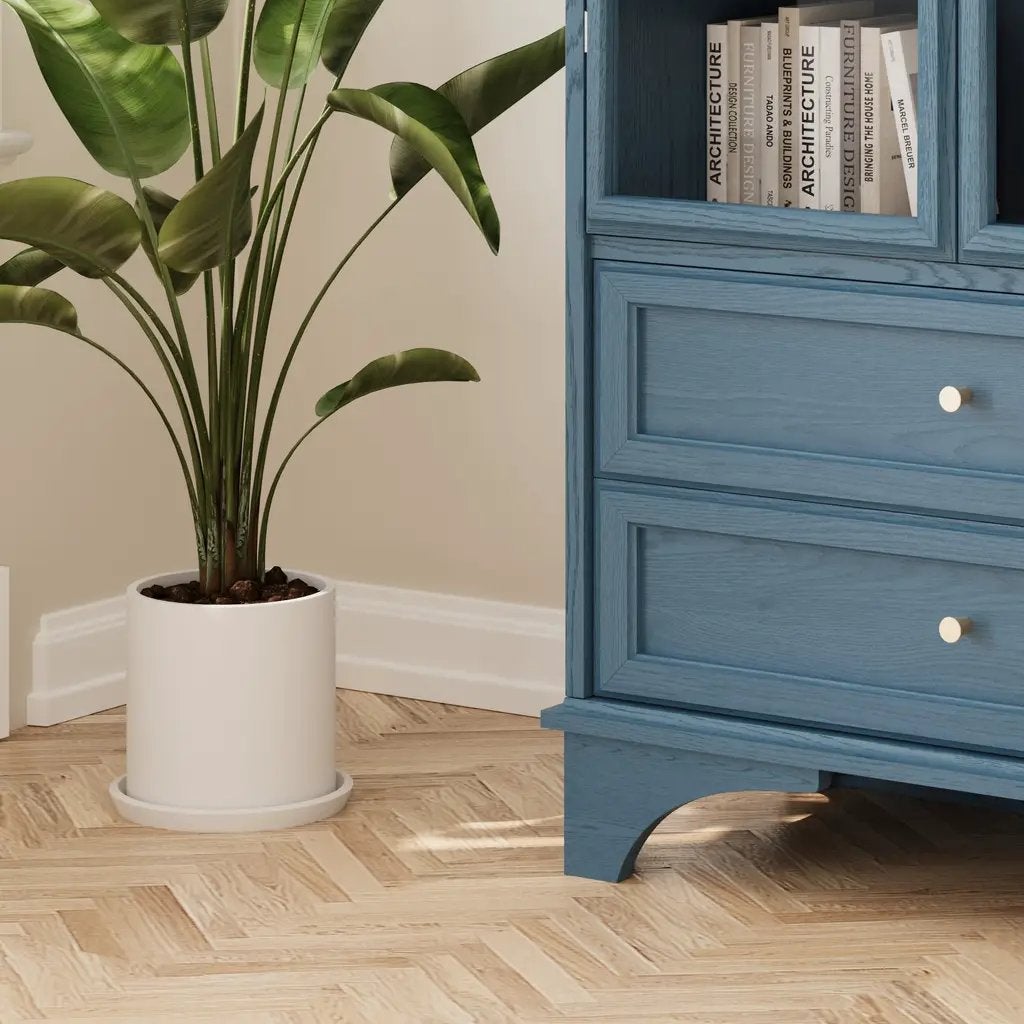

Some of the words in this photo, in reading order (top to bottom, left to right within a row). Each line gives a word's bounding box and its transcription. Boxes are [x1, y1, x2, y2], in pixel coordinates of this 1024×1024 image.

[728, 82, 737, 109] DESIGN
[743, 42, 755, 137] FURNITURE
[782, 48, 792, 117] BLUEPRINTS
[823, 75, 833, 124] Constructing
[843, 24, 855, 142] FURNITURE
[864, 72, 874, 95] HOME
[709, 42, 721, 186] ARCHITECTURE
[728, 111, 737, 153] COLLECTION
[782, 119, 792, 127] &
[801, 45, 815, 197] ARCHITECTURE
[864, 96, 874, 123] HOUSE
[864, 125, 874, 141] THE
[897, 99, 909, 133] MARCEL
[903, 135, 916, 169] BREUER
[782, 130, 792, 189] BUILDINGS
[825, 126, 834, 158] Paradies
[864, 143, 874, 183] BRINGING
[743, 143, 755, 203] DESIGN
